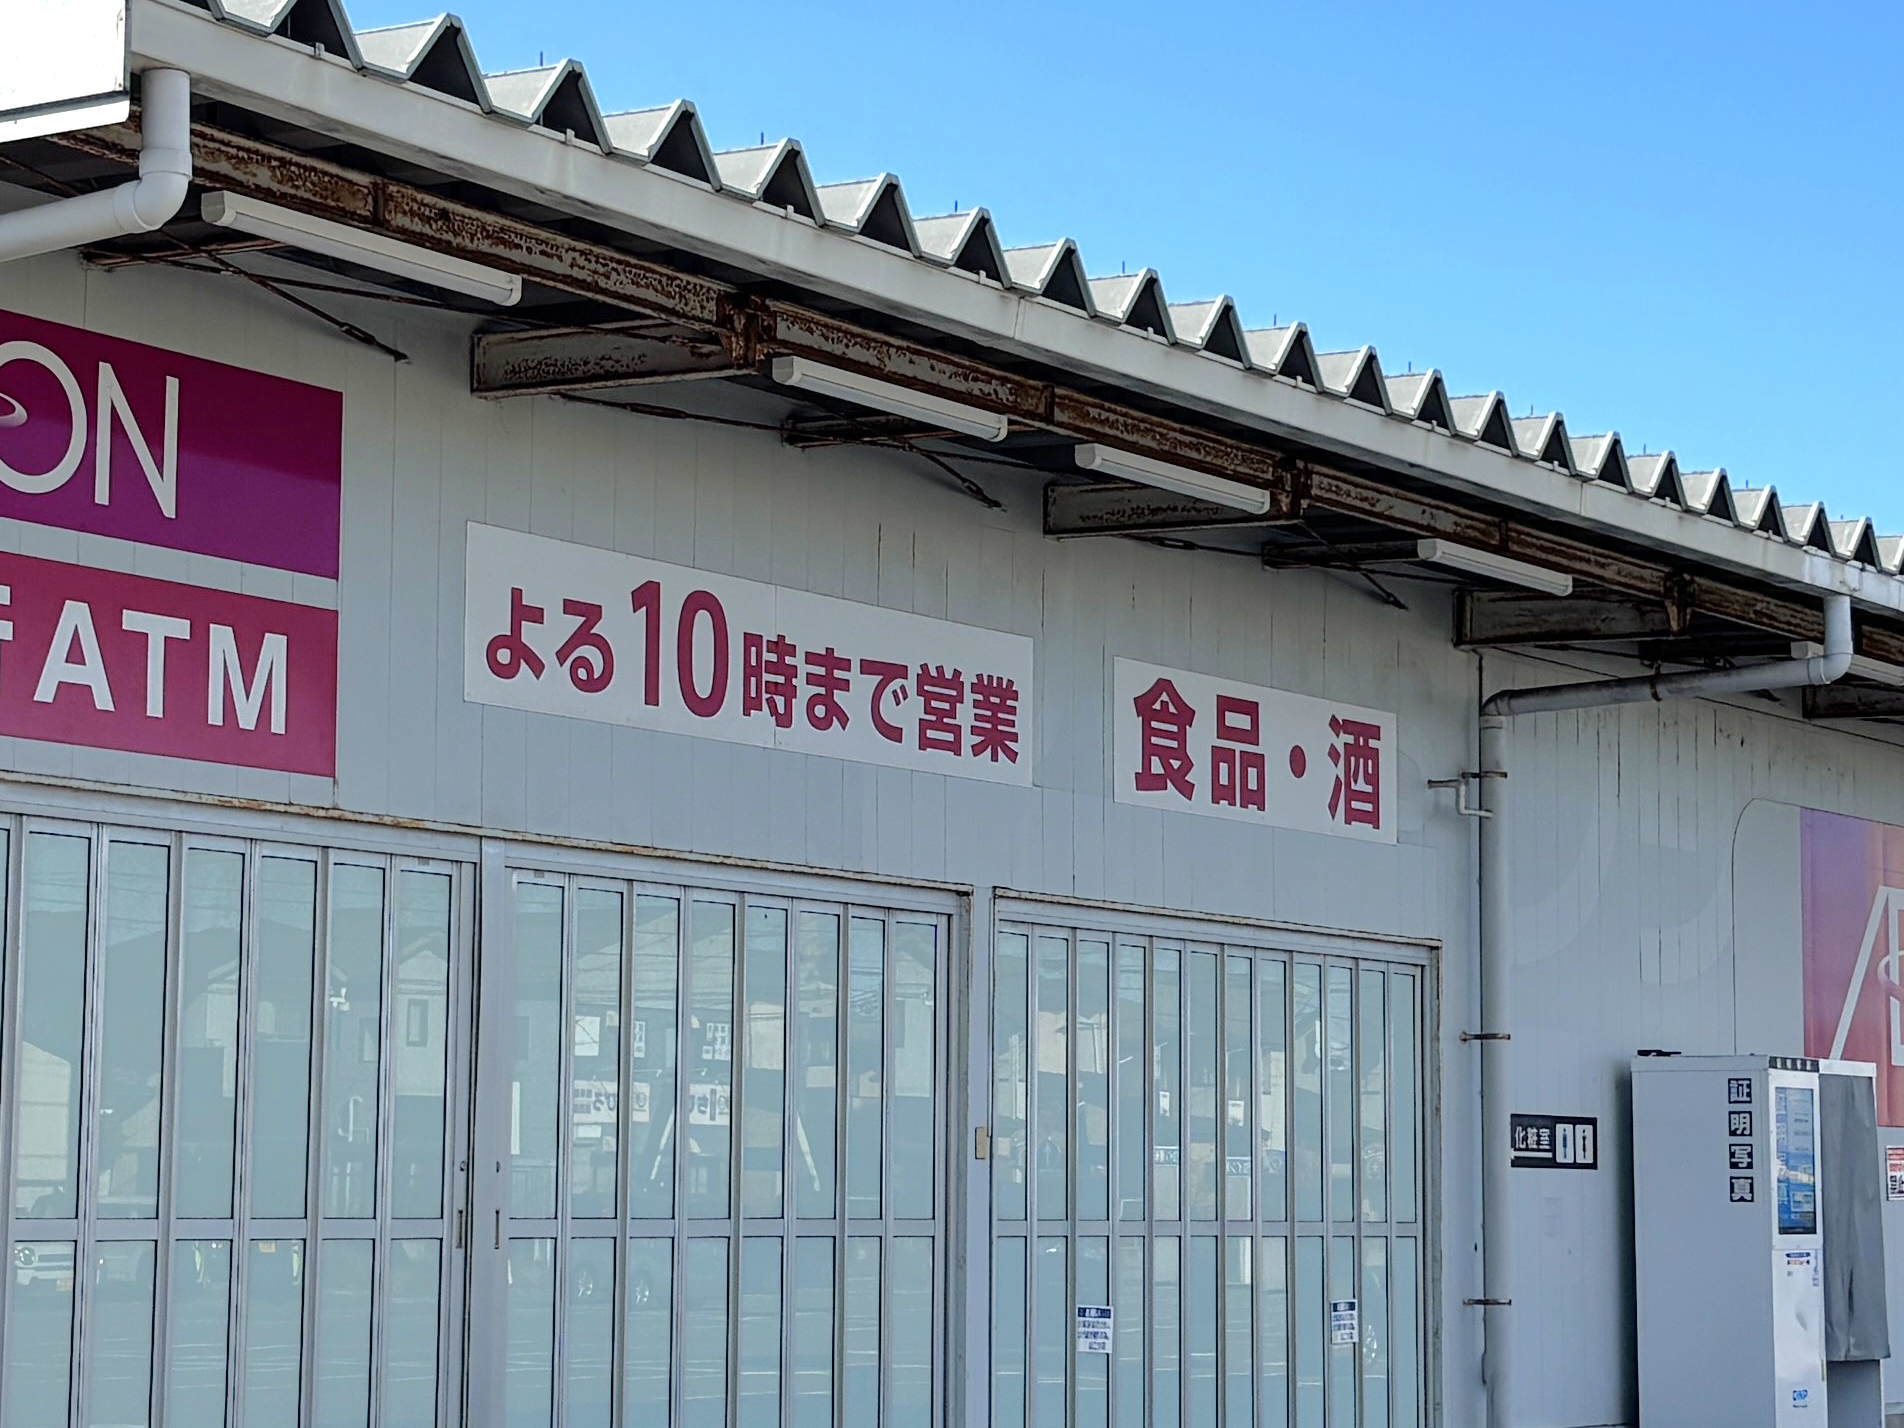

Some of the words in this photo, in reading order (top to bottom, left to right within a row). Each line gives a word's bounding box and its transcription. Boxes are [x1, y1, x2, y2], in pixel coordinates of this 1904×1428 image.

[484, 578, 1022, 766] よる10時まで営業
[1132, 675, 1384, 832] 食品・酒
[1515, 1126, 1551, 1149] 化粧室
[1730, 1079, 1752, 1201] 証明写真
